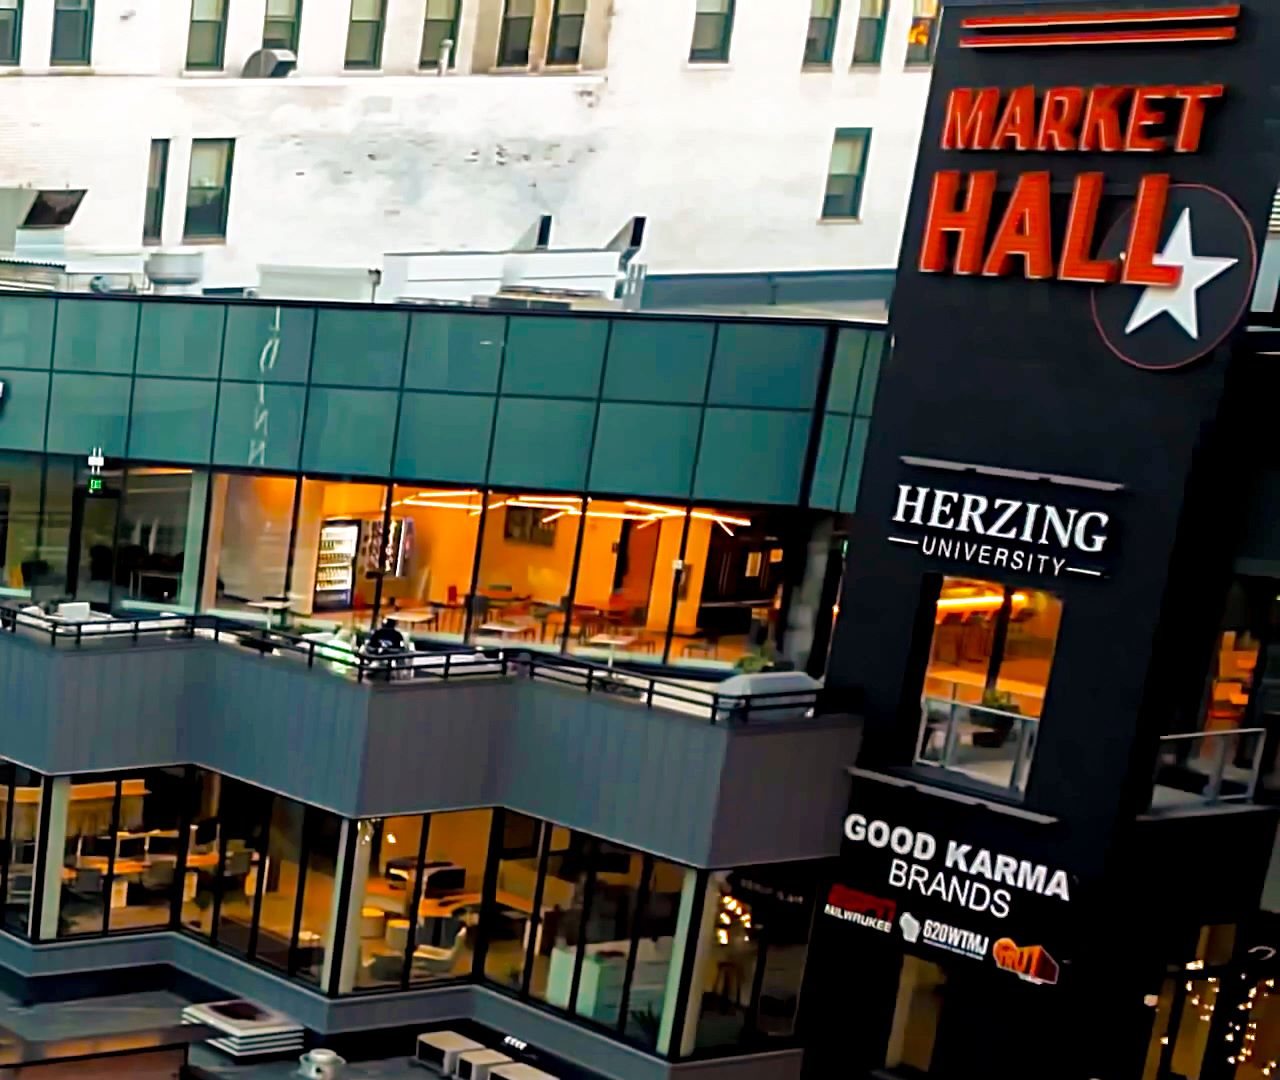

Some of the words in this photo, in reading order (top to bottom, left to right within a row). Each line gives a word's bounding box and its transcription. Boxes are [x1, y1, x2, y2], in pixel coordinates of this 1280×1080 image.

[940, 83, 1224, 153] MARKET
[918, 169, 1183, 288] HALL
[892, 484, 1110, 553] HERZING
[921, 535, 1066, 577] UNIVERSITY
[843, 813, 937, 861] GOOD
[944, 840, 1071, 901] KARMA
[888, 858, 1013, 919] BRANDS
